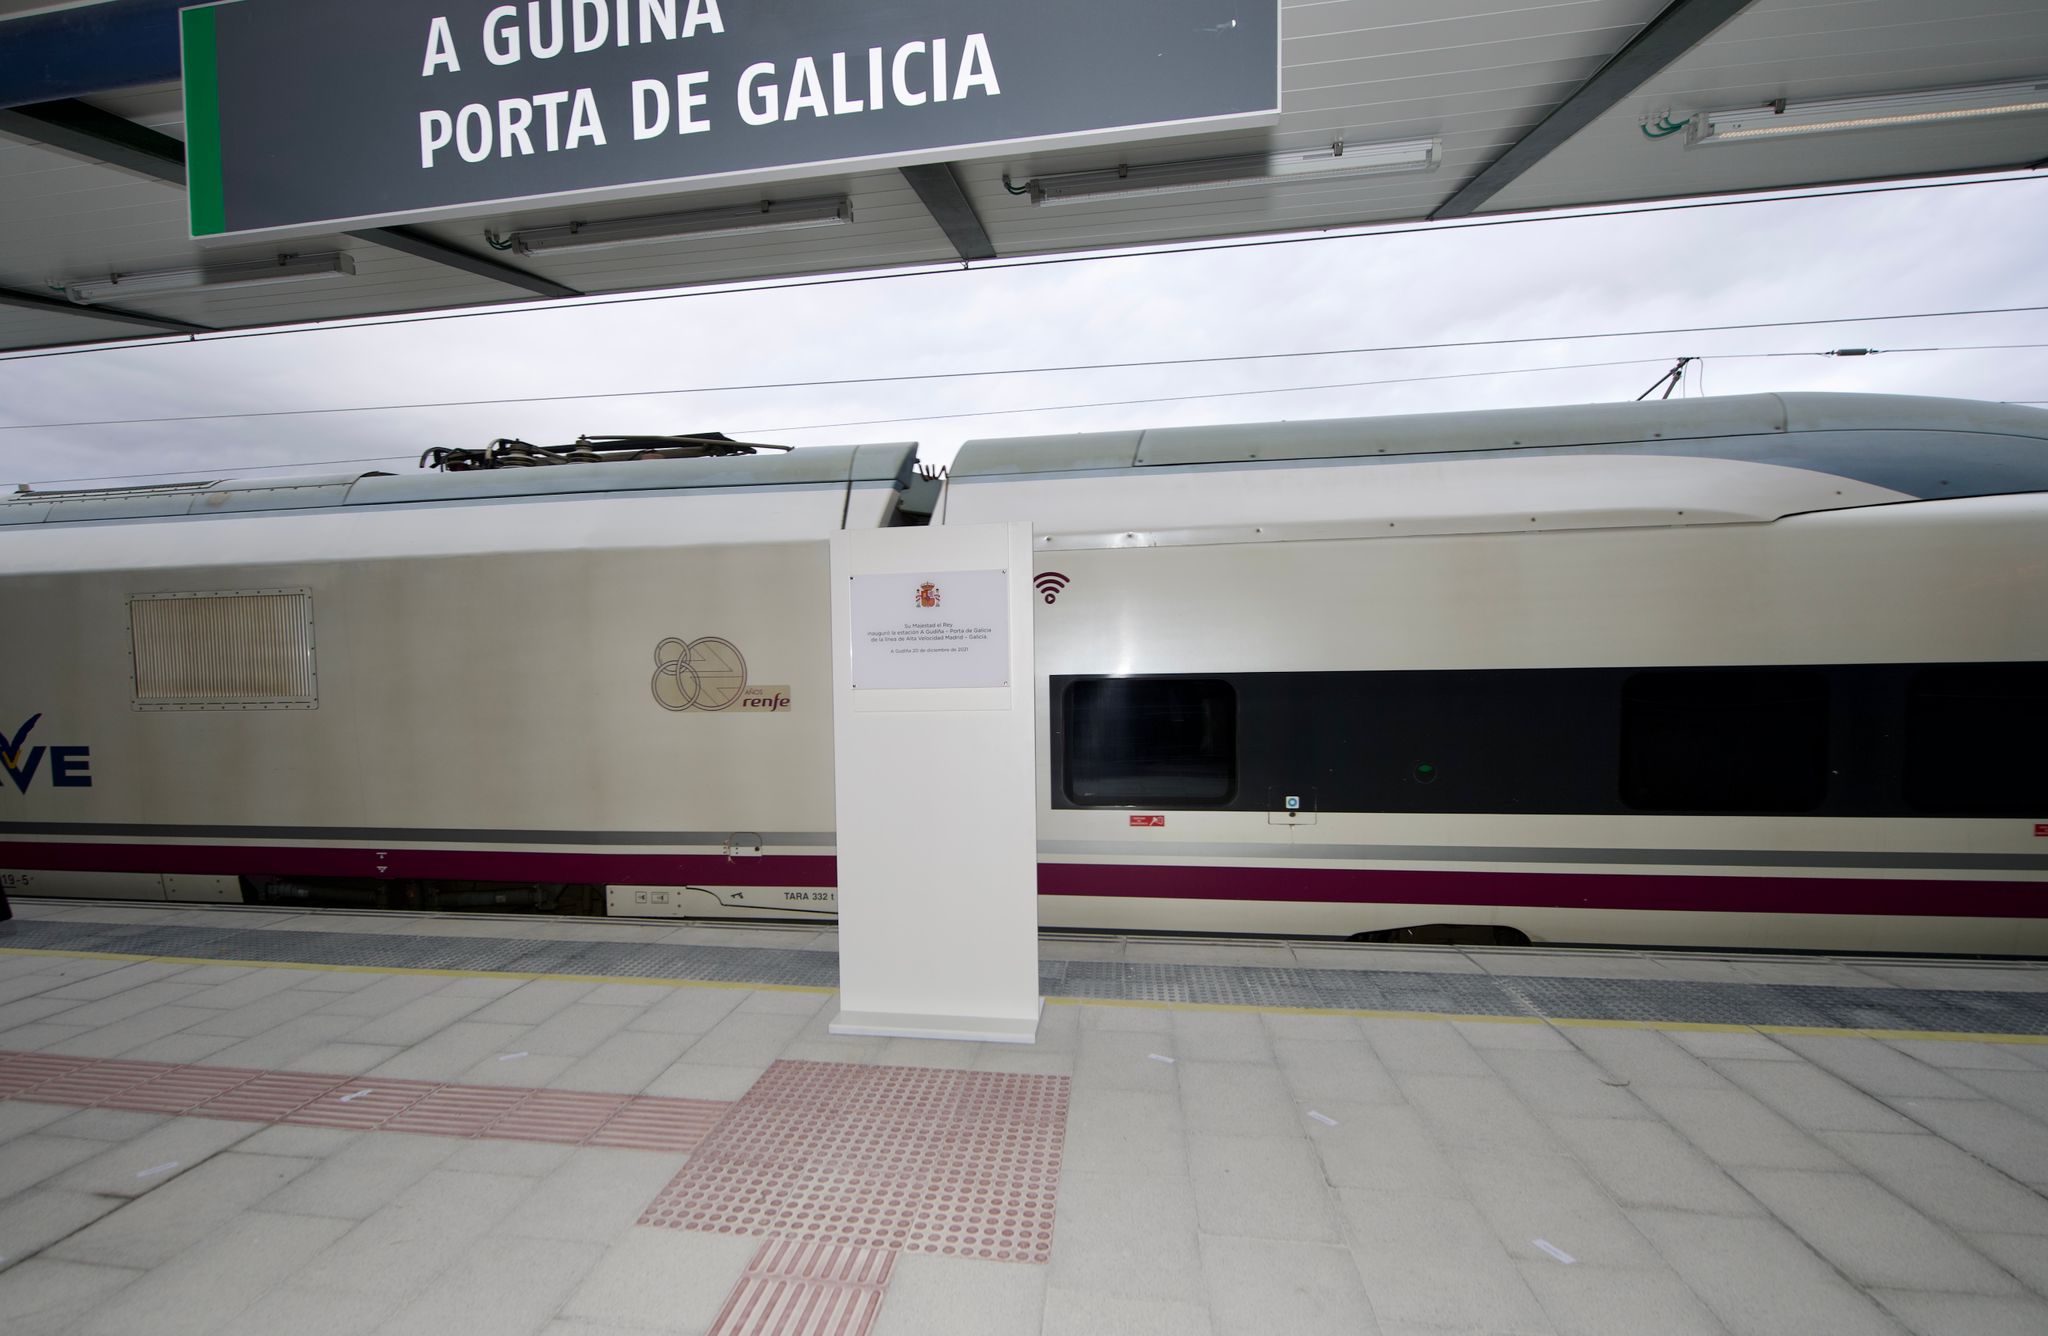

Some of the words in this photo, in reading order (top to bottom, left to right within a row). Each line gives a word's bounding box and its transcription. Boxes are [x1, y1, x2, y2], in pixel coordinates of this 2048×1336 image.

[423, 17, 461, 77] A
[420, 88, 609, 169] PORTA
[632, 71, 711, 141] DE
[738, 33, 1001, 126] GALICIA
[743, 692, 790, 712] renfe
[0, 746, 93, 795] VE
[784, 892, 809, 901] TARA
[812, 892, 828, 901] 332
[830, 892, 835, 901] t
